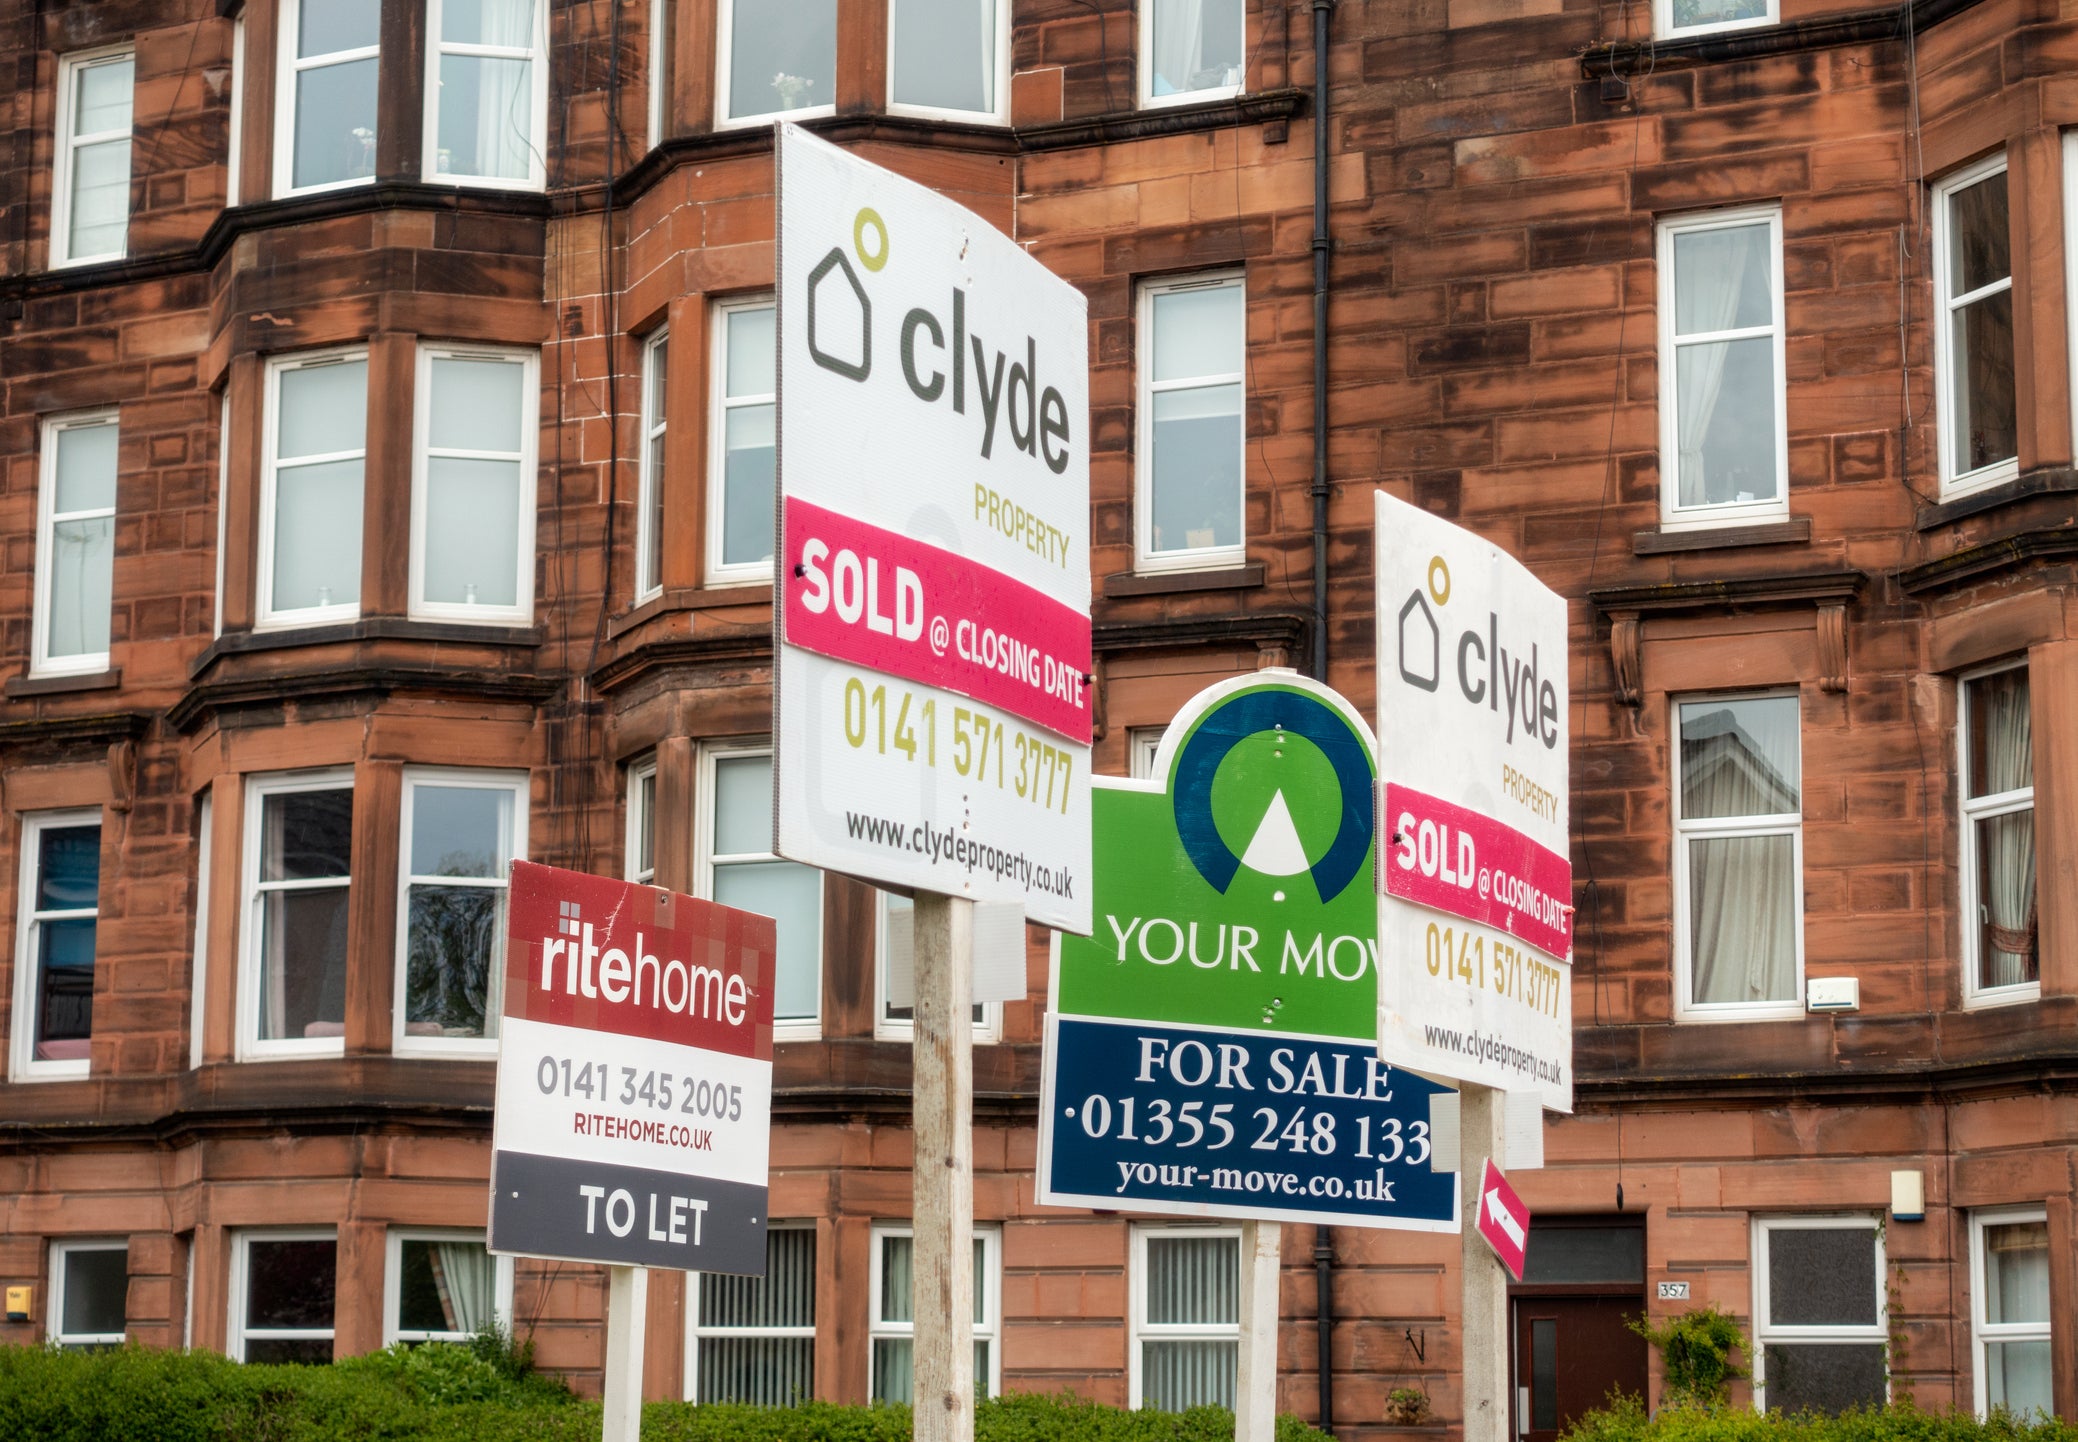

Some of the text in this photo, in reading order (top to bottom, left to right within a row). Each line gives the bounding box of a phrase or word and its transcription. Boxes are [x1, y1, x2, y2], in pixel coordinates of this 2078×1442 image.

[900, 286, 1070, 474] clyde
[974, 482, 1070, 569] PROPERTY
[801, 537, 1084, 709] SOLD @ CLOSING DATE
[1457, 611, 1558, 749] clyde
[844, 677, 1072, 815] 0141 571 3777
[1503, 764, 1558, 824] PROPERTY
[846, 810, 1073, 899] www.clydeproperty.co.uk
[1397, 812, 1567, 934] SOLD @ CLOSING DATE
[541, 920, 747, 1026] ritehome
[1106, 914, 1261, 973] YOUR
[1426, 922, 1560, 1018] 0141 571 3777
[537, 1056, 742, 1122] 0141 345 2005
[1135, 1037, 1393, 1102] FOR SALE
[1425, 1024, 1561, 1085] www.clydeproperty.co.uk
[574, 1113, 713, 1151] RITEHOME.CO.UK
[1081, 1094, 1431, 1165] 01355 248 133
[579, 1185, 708, 1246] TO LET
[1116, 1160, 1396, 1202] your-move.co.uk
[1661, 1284, 1687, 1296] 357
